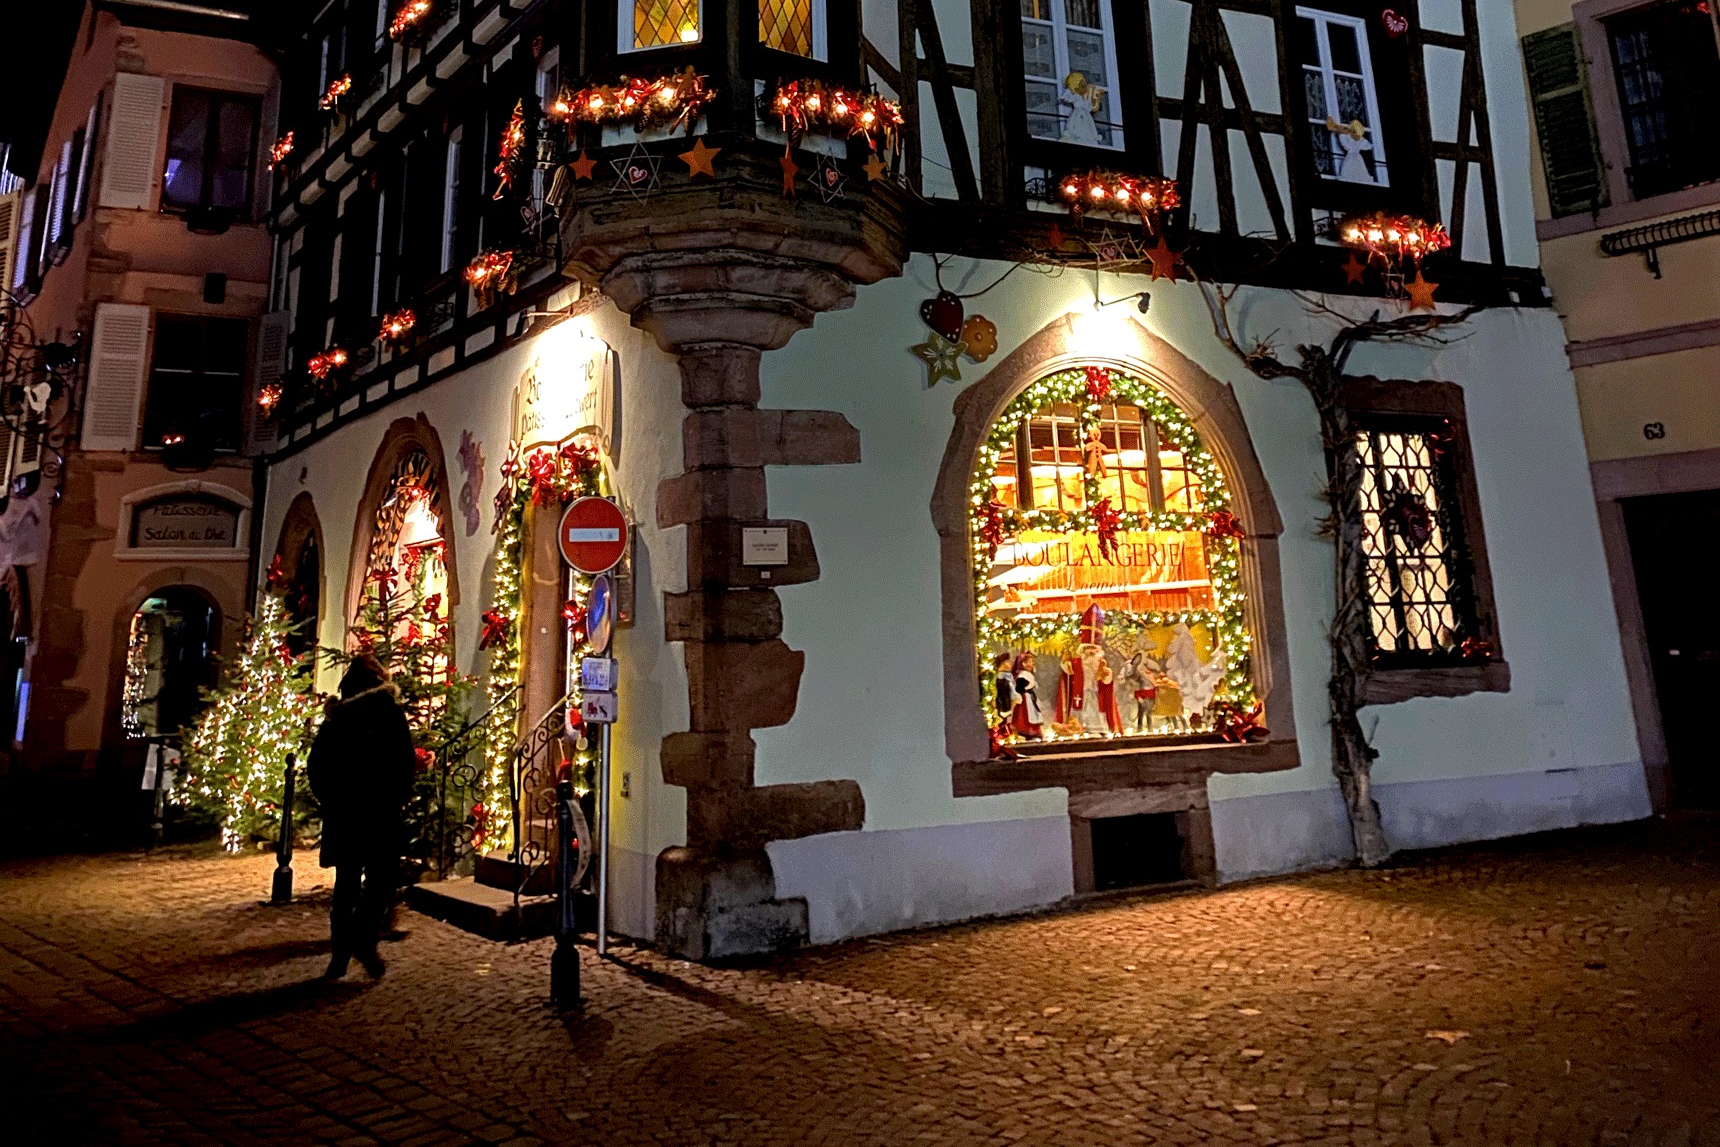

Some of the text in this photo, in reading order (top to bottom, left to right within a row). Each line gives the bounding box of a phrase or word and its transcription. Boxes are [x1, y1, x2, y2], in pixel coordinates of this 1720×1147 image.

[1644, 422, 1665, 440] 63
[144, 526, 187, 541] Salon
[1013, 542, 1182, 567] BOULANGERIE
